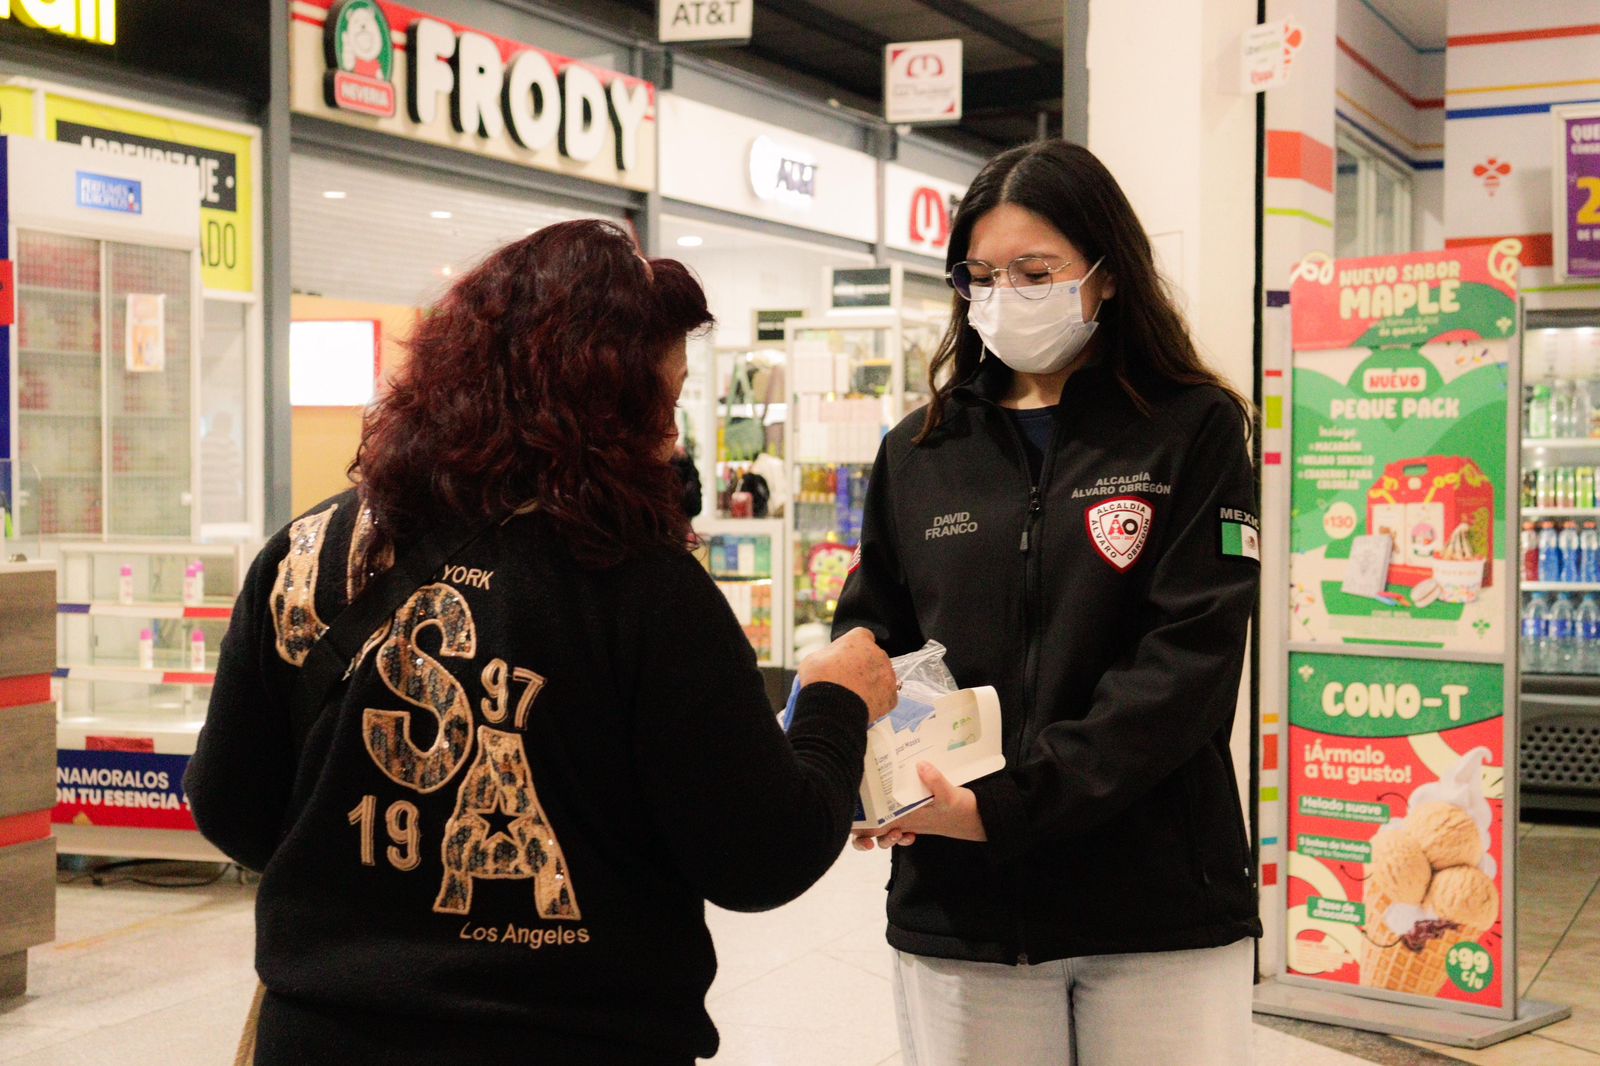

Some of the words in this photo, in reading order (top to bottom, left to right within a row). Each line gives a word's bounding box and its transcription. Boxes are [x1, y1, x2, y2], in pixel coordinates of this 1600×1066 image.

[672, 0, 741, 27] AT&T
[409, 18, 648, 171] FRODY
[200, 220, 236, 269] DO
[1340, 266, 1398, 287] NUEVO
[1402, 260, 1460, 283] SABOR
[1339, 279, 1460, 320] MAPLE
[1369, 374, 1420, 388] NUEVO
[1330, 398, 1397, 420] PEQUE
[1402, 397, 1460, 420] PACK
[1071, 487, 1116, 499] ÁLVARO
[1118, 482, 1171, 495] OBREGÓN
[1095, 471, 1151, 487] ALCALDÍA
[925, 522, 978, 540] FRANCO
[933, 511, 970, 527] DAVID
[442, 564, 494, 590] YORK
[481, 658, 547, 730] 97
[1322, 682, 1469, 721] CONO-T
[1305, 740, 1385, 765] ¡Ármalo
[1305, 765, 1319, 778] a
[1321, 763, 1344, 780] tu
[1346, 766, 1412, 784] gusto!
[78, 788, 101, 806] TU
[103, 790, 181, 811] ESENCIA
[1302, 796, 1344, 811] Helado
[1345, 803, 1382, 816] suave
[347, 795, 422, 871] 19
[459, 921, 498, 942] Los
[501, 923, 590, 949] Angeles
